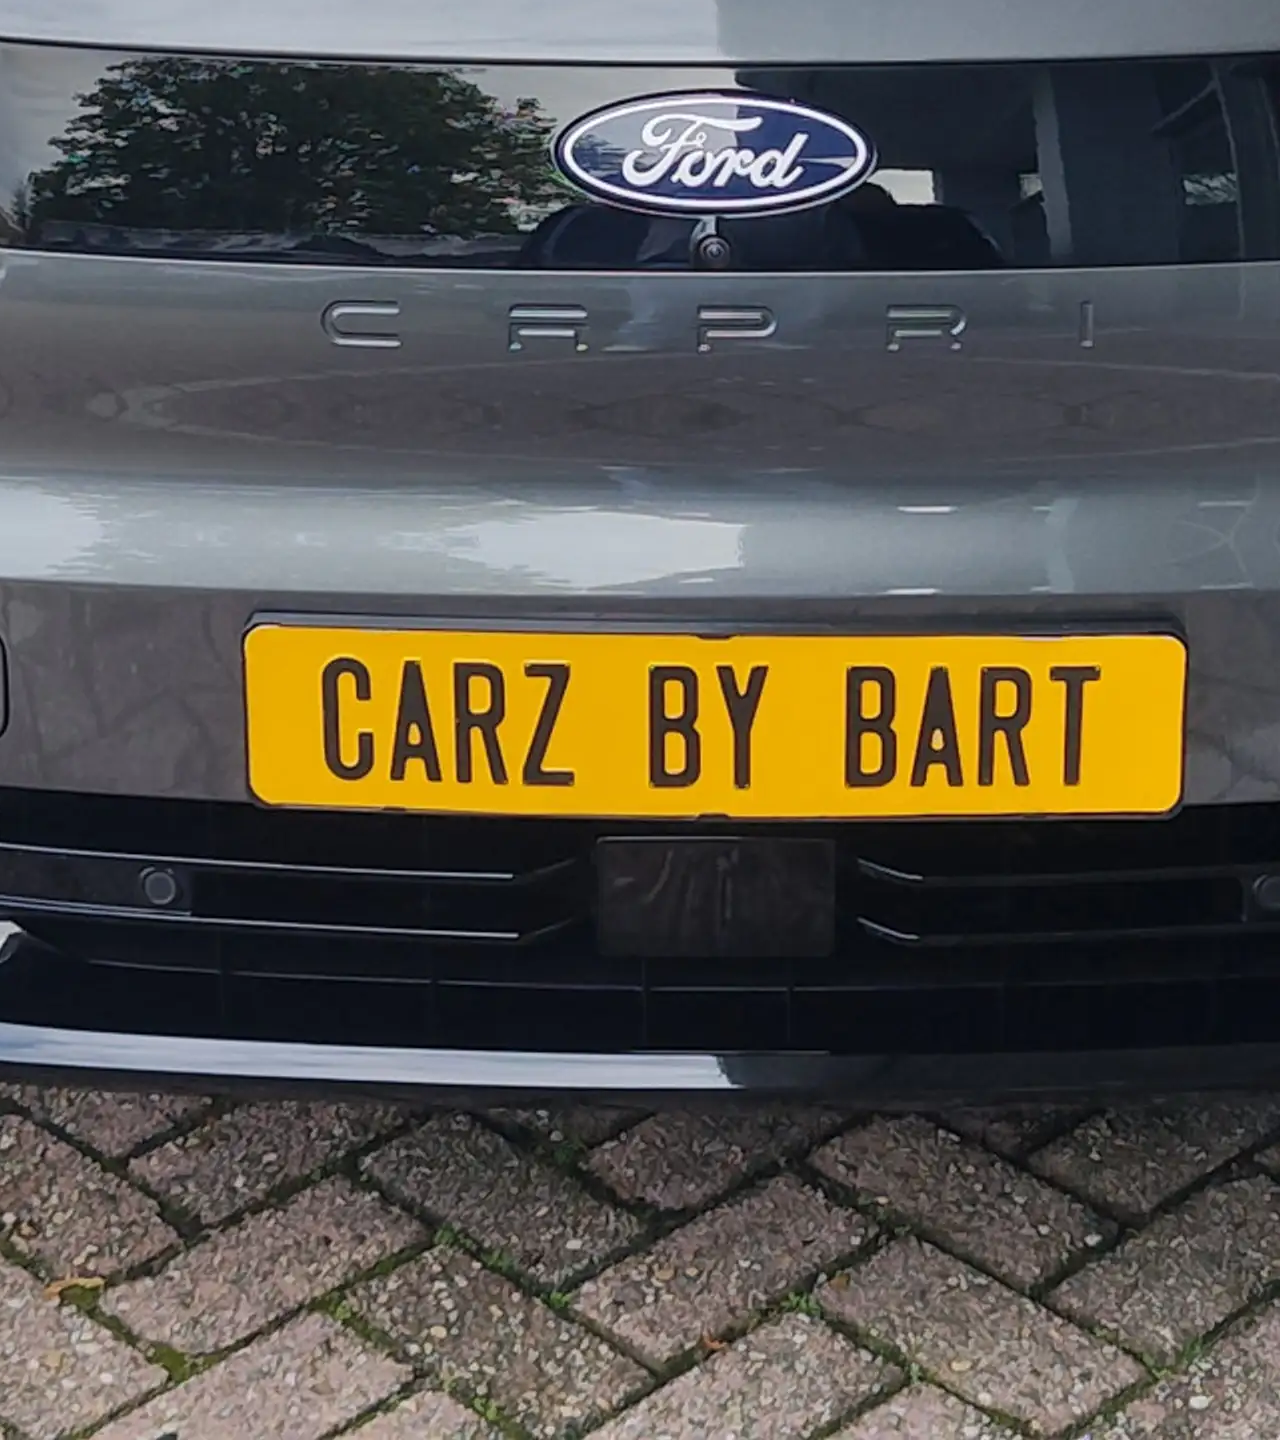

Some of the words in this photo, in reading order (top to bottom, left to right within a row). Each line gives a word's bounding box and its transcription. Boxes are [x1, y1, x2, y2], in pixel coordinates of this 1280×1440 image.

[622, 113, 809, 188] Ford
[320, 299, 1094, 353] CAPRI
[321, 657, 575, 786] CARZ
[648, 664, 768, 789] BY
[844, 664, 1102, 788] BART
